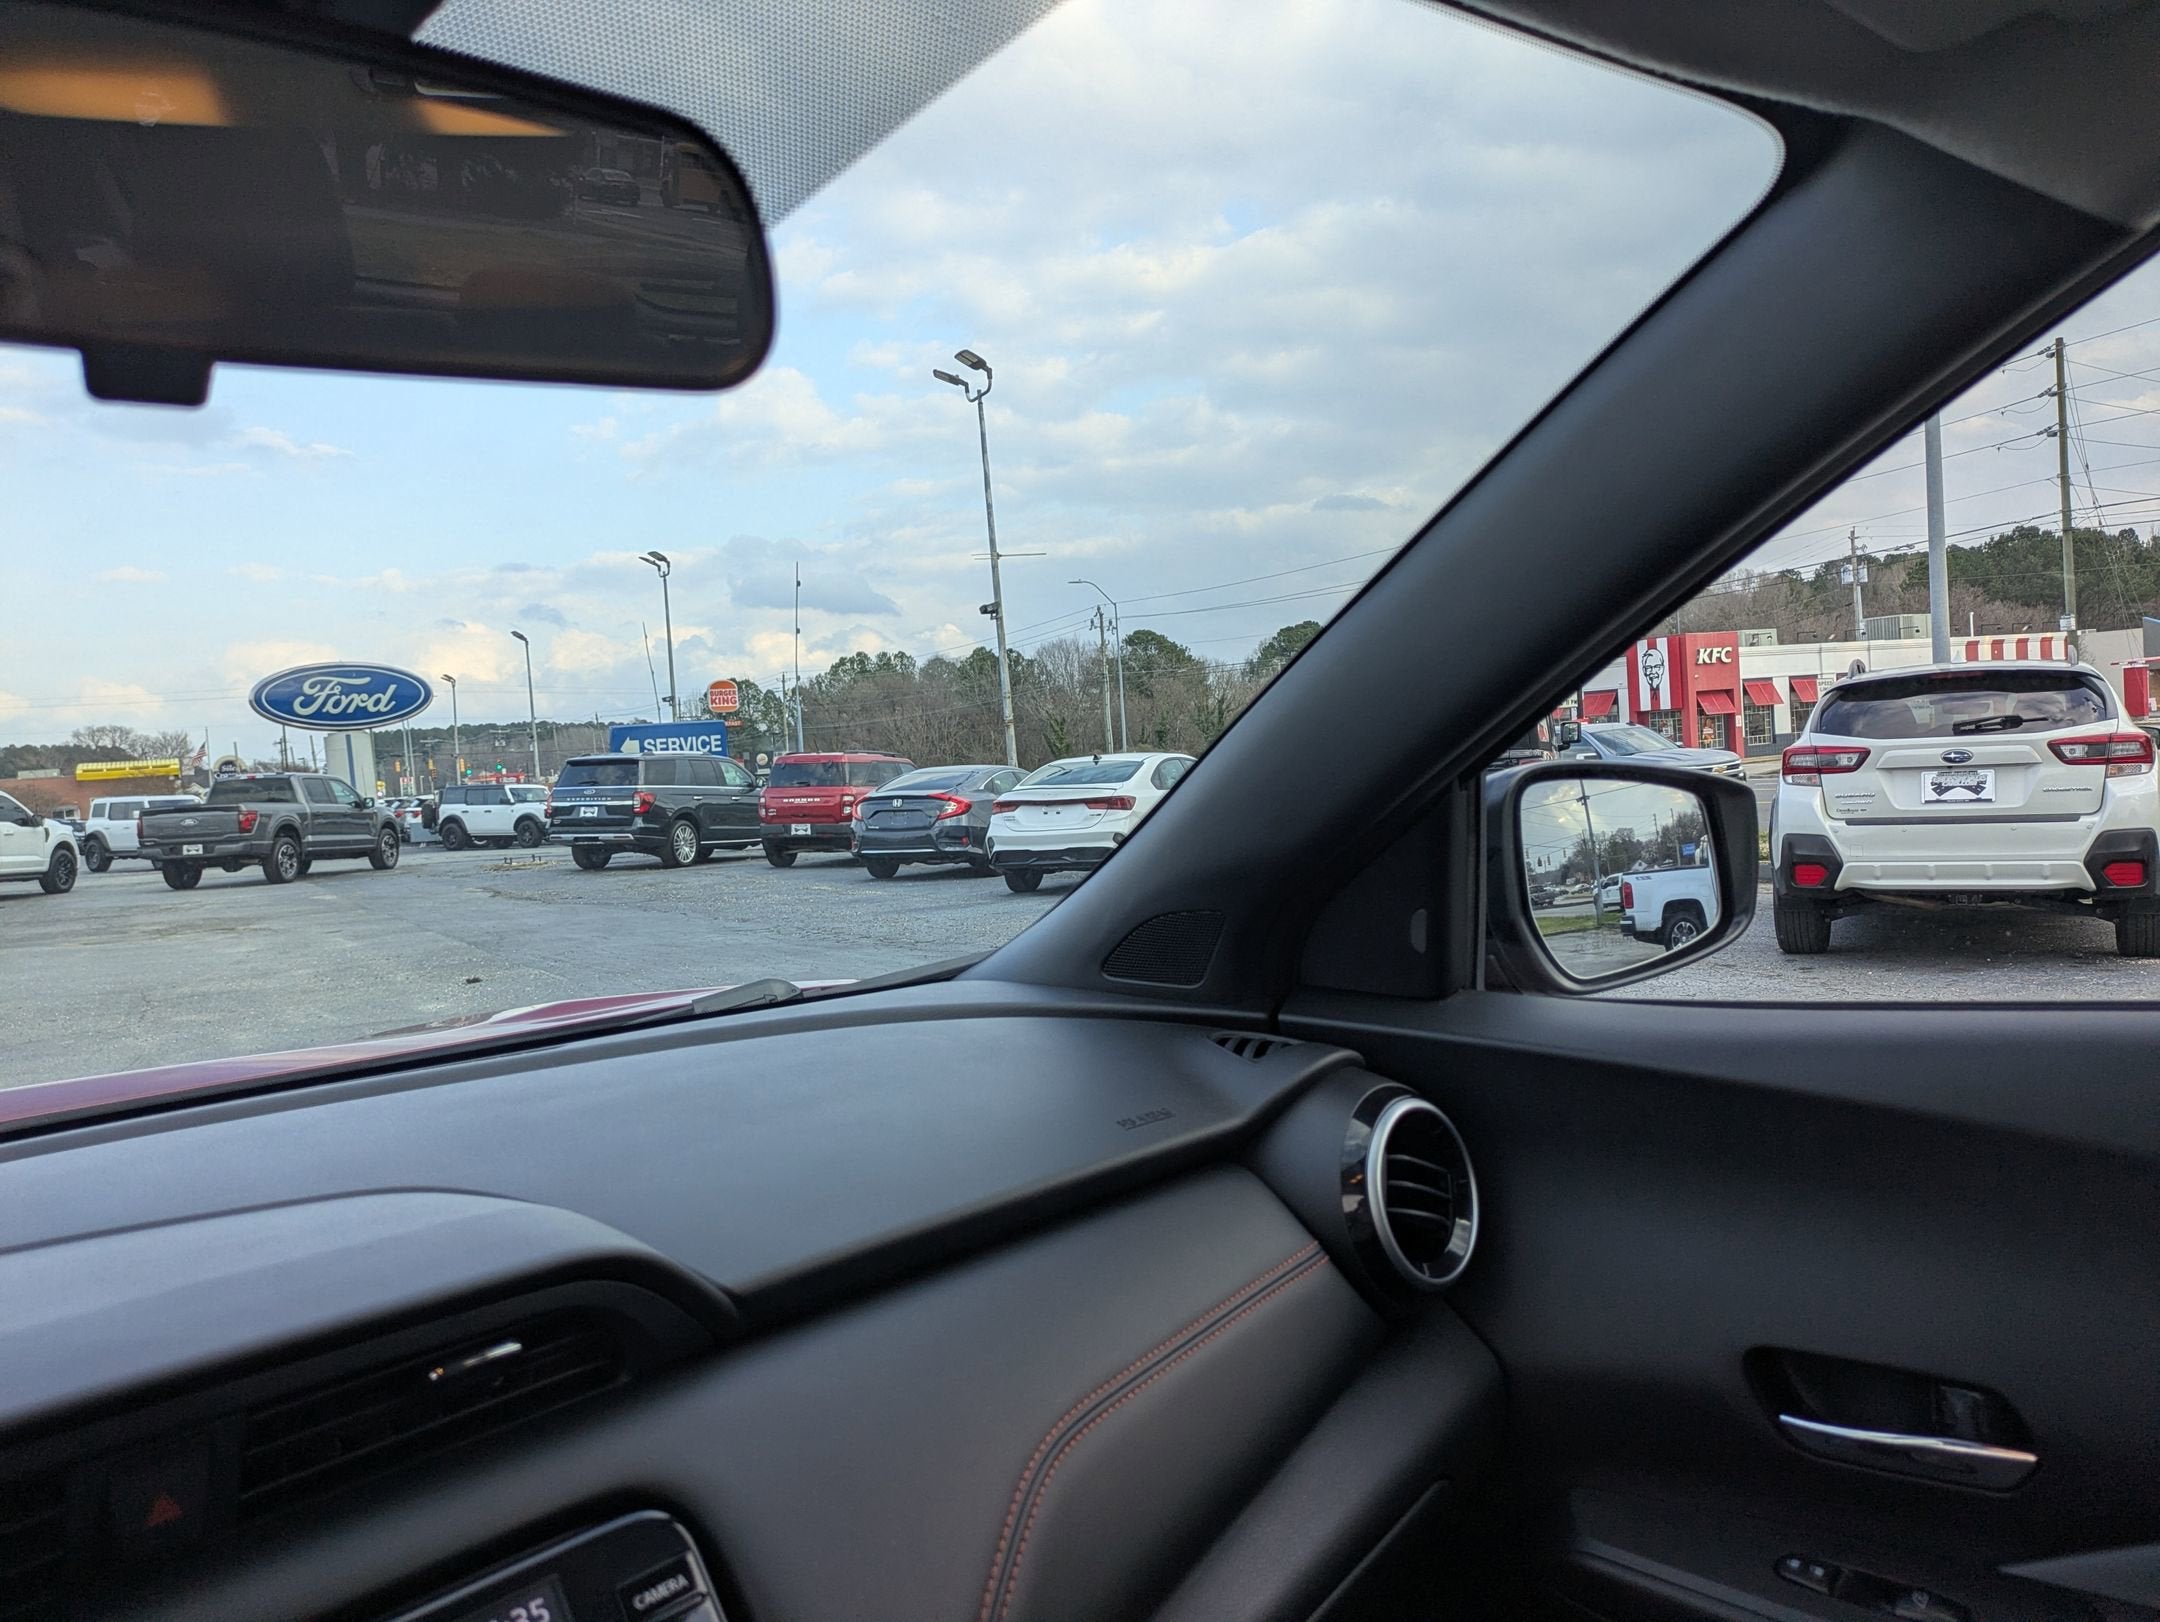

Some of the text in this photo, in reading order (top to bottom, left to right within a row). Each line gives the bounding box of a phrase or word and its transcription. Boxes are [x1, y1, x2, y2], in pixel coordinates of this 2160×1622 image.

[1696, 646, 1733, 665] KFC
[293, 677, 398, 716] Ford
[710, 689, 737, 697] BURGER
[710, 697, 738, 706] KING
[643, 735, 723, 754] SERVICE
[633, 1574, 690, 1611] CAMERA
